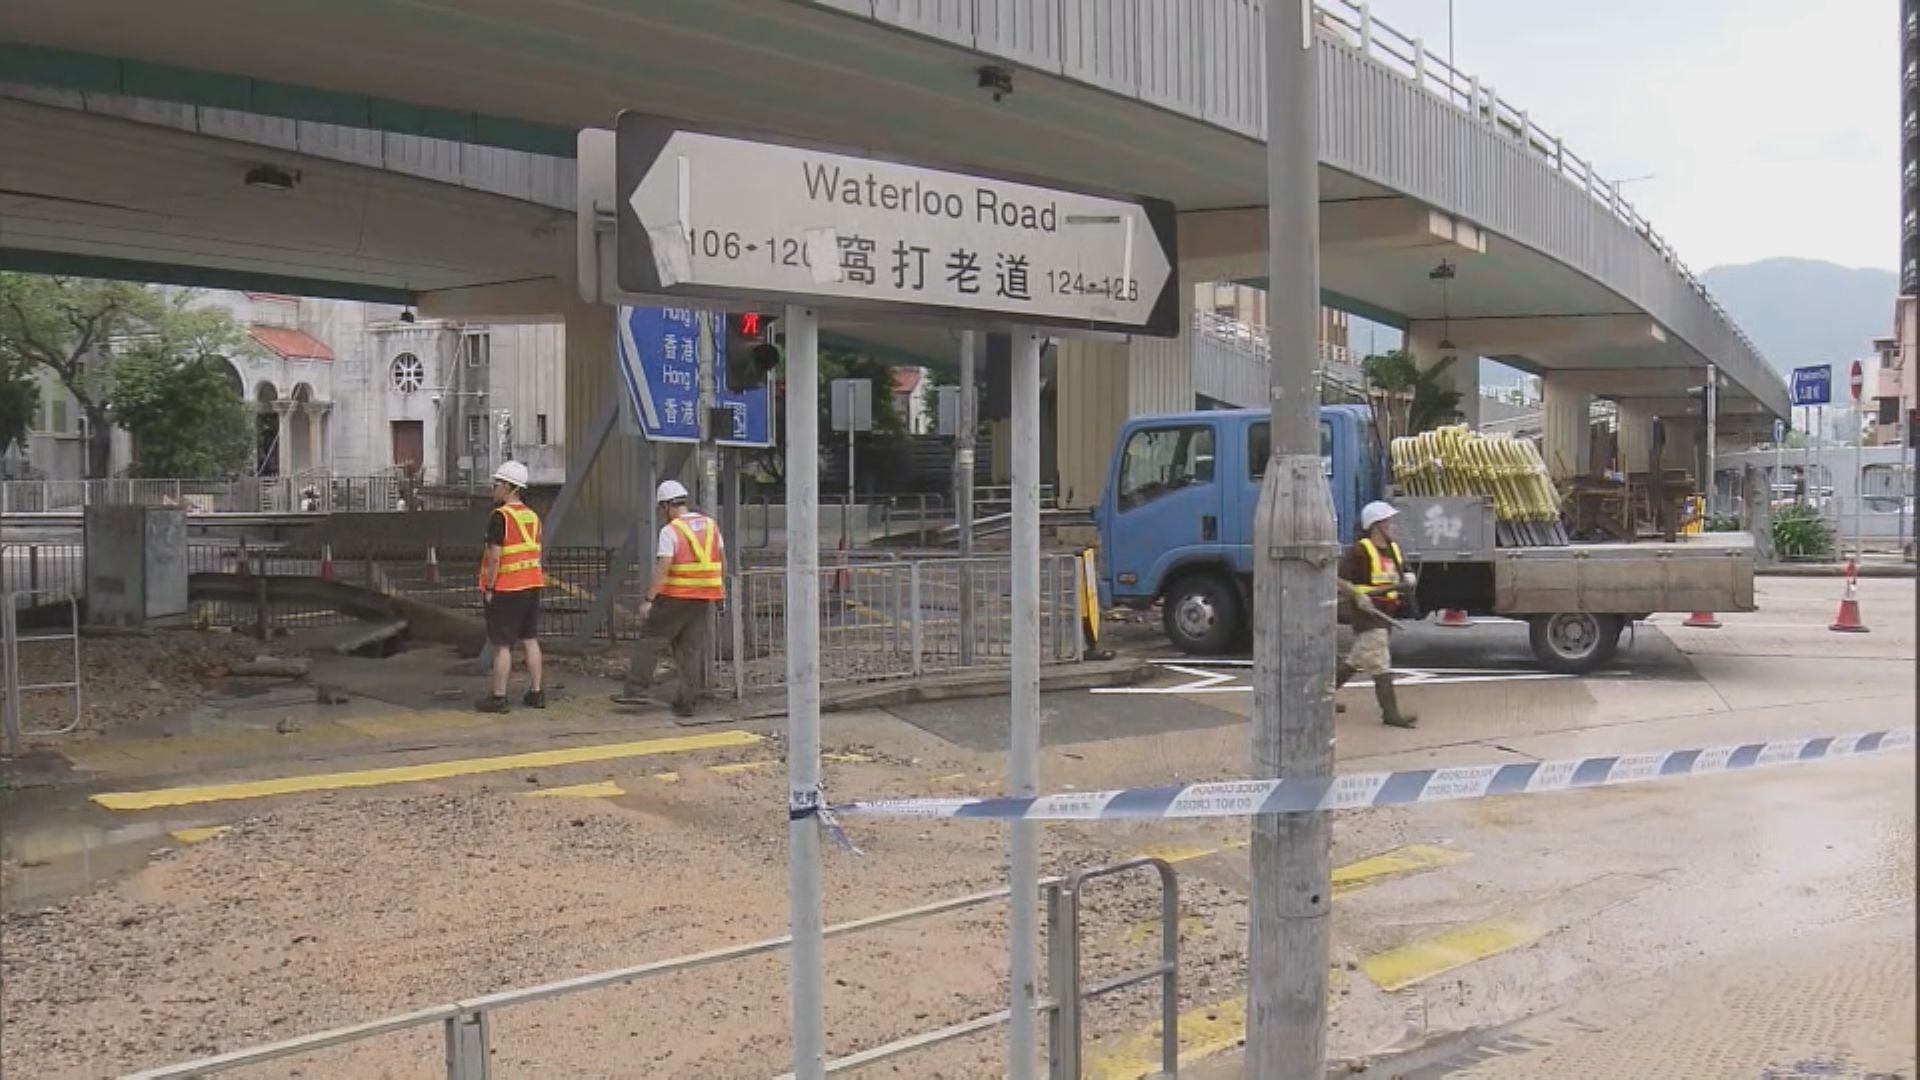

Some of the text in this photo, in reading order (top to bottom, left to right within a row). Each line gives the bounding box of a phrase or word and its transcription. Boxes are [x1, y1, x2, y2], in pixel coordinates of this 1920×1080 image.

[803, 161, 1056, 232] Waterloo Road
[833, 233, 1031, 300] 窩打老道
[663, 364, 690, 391] Hong
[1423, 504, 1462, 546] 和
